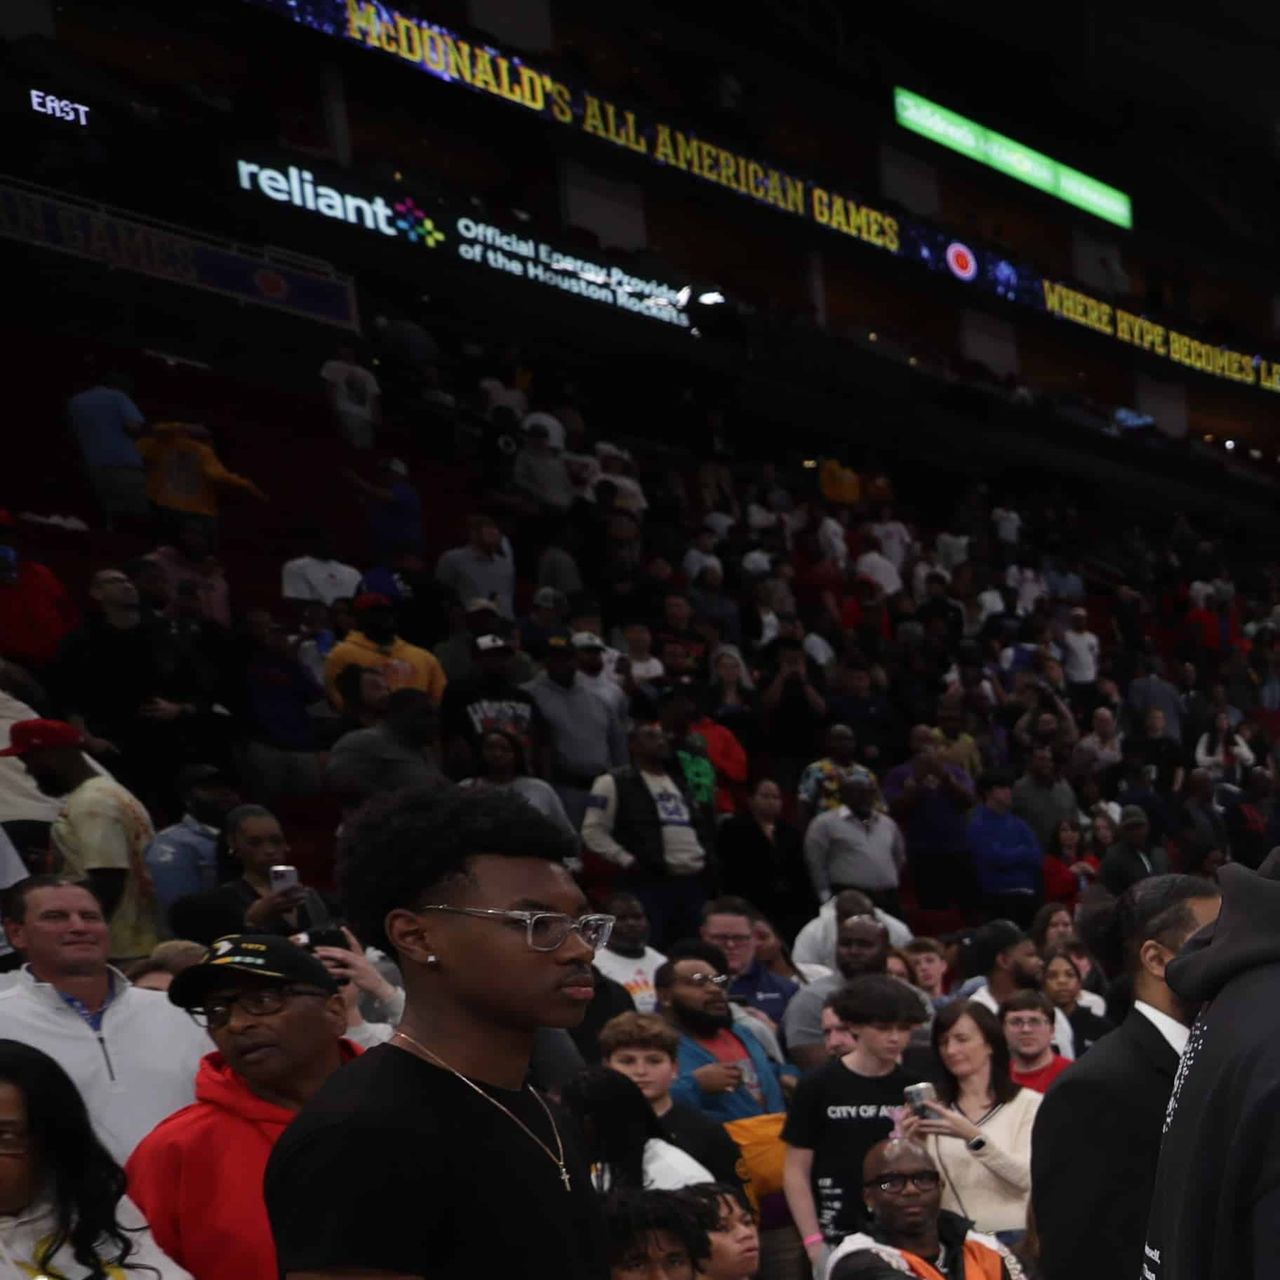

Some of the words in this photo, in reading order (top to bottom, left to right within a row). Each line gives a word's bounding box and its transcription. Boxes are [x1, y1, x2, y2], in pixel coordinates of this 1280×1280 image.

[29, 88, 91, 127] EAST
[346, 0, 573, 124] McDONALD'S
[581, 94, 648, 155] ALL
[654, 122, 805, 217] AMERICAN
[811, 186, 900, 255] GAMES
[237, 159, 398, 236] reliant
[456, 216, 534, 259] Official
[540, 244, 607, 283] Energy
[459, 243, 484, 262] of
[486, 248, 524, 276] the
[527, 260, 614, 304] Houston
[1042, 279, 1115, 337] WHERE
[1115, 308, 1168, 357] HYPE
[1169, 329, 1257, 386] BECOMES
[826, 1105, 857, 1120] CITY
[859, 1104, 880, 1119] OF
